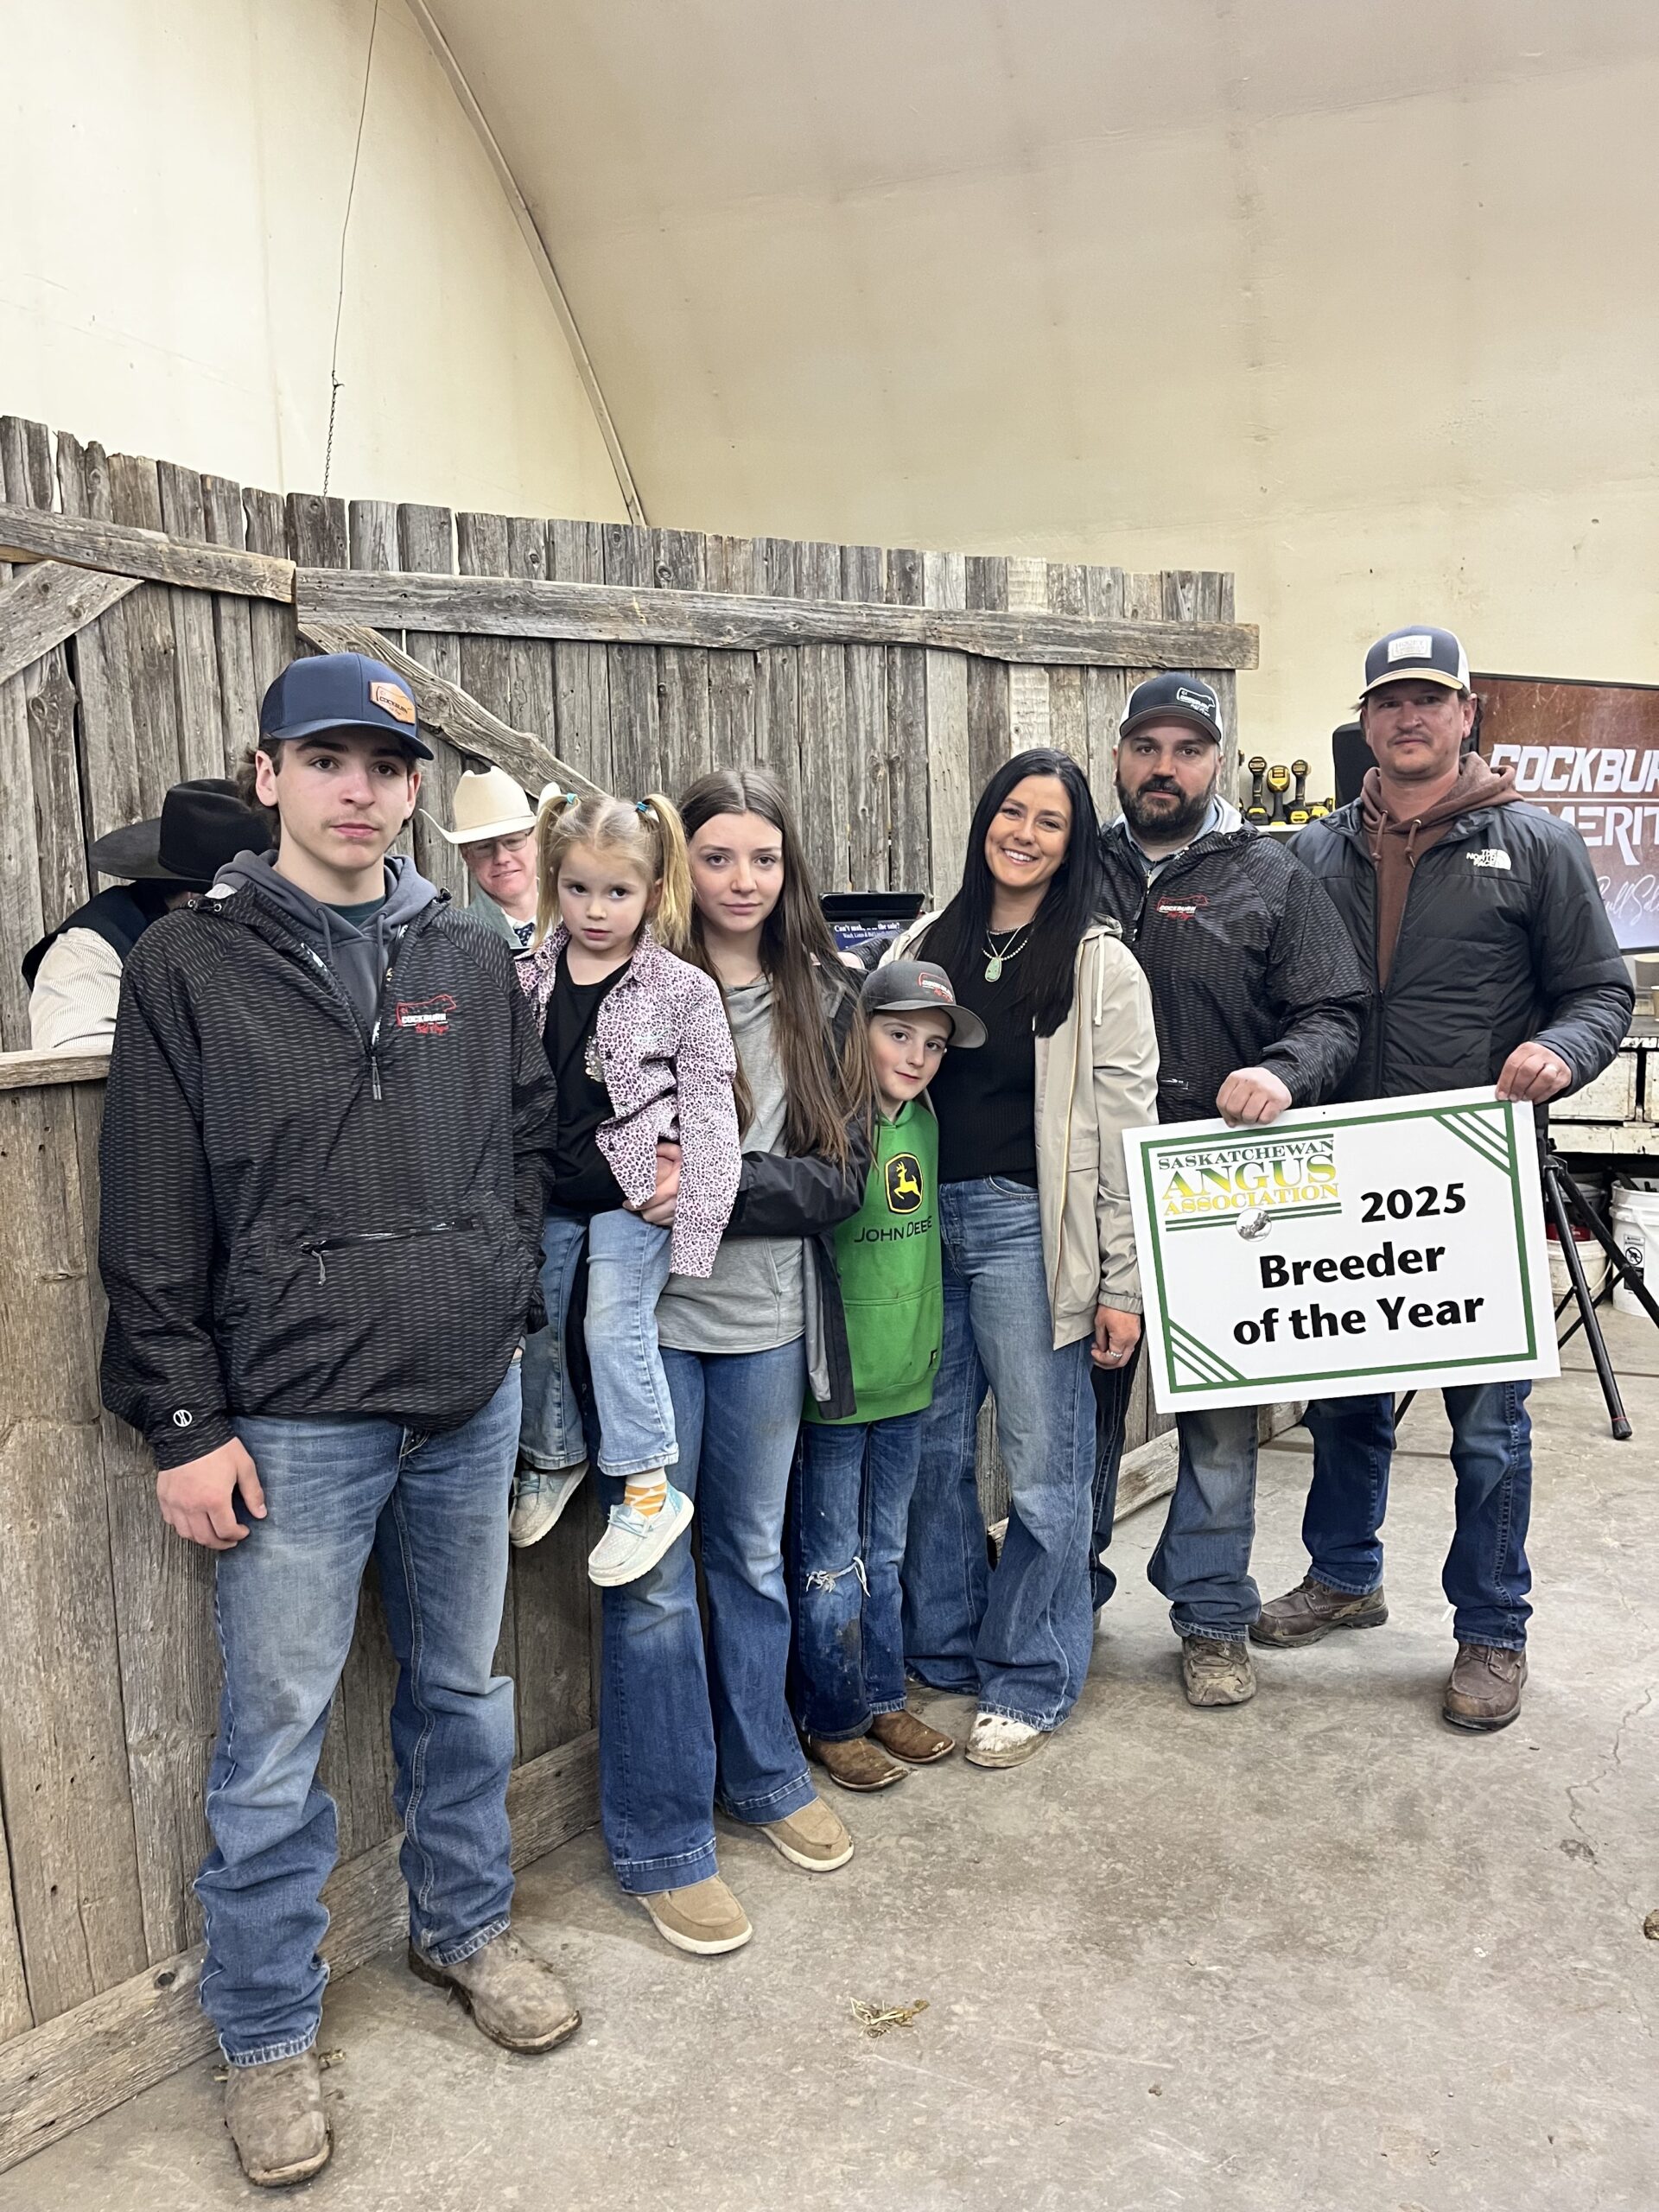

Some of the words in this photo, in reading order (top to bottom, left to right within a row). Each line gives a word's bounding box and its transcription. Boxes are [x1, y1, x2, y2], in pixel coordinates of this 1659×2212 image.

[1466, 852, 1496, 862] NORTH
[401, 1013, 447, 1024] COCKBURN
[1158, 1139, 1335, 1170] SASKATCHEWAN
[1161, 1153, 1337, 1200] ANGUS
[1163, 1183, 1339, 1217] ASSOCIATION
[1361, 1182, 1466, 1224] 2025
[854, 1226, 905, 1243] JOHN
[1259, 1241, 1446, 1289] Breeder
[1233, 1307, 1279, 1345] of
[1288, 1303, 1366, 1340] the
[1376, 1296, 1484, 1331] Year
